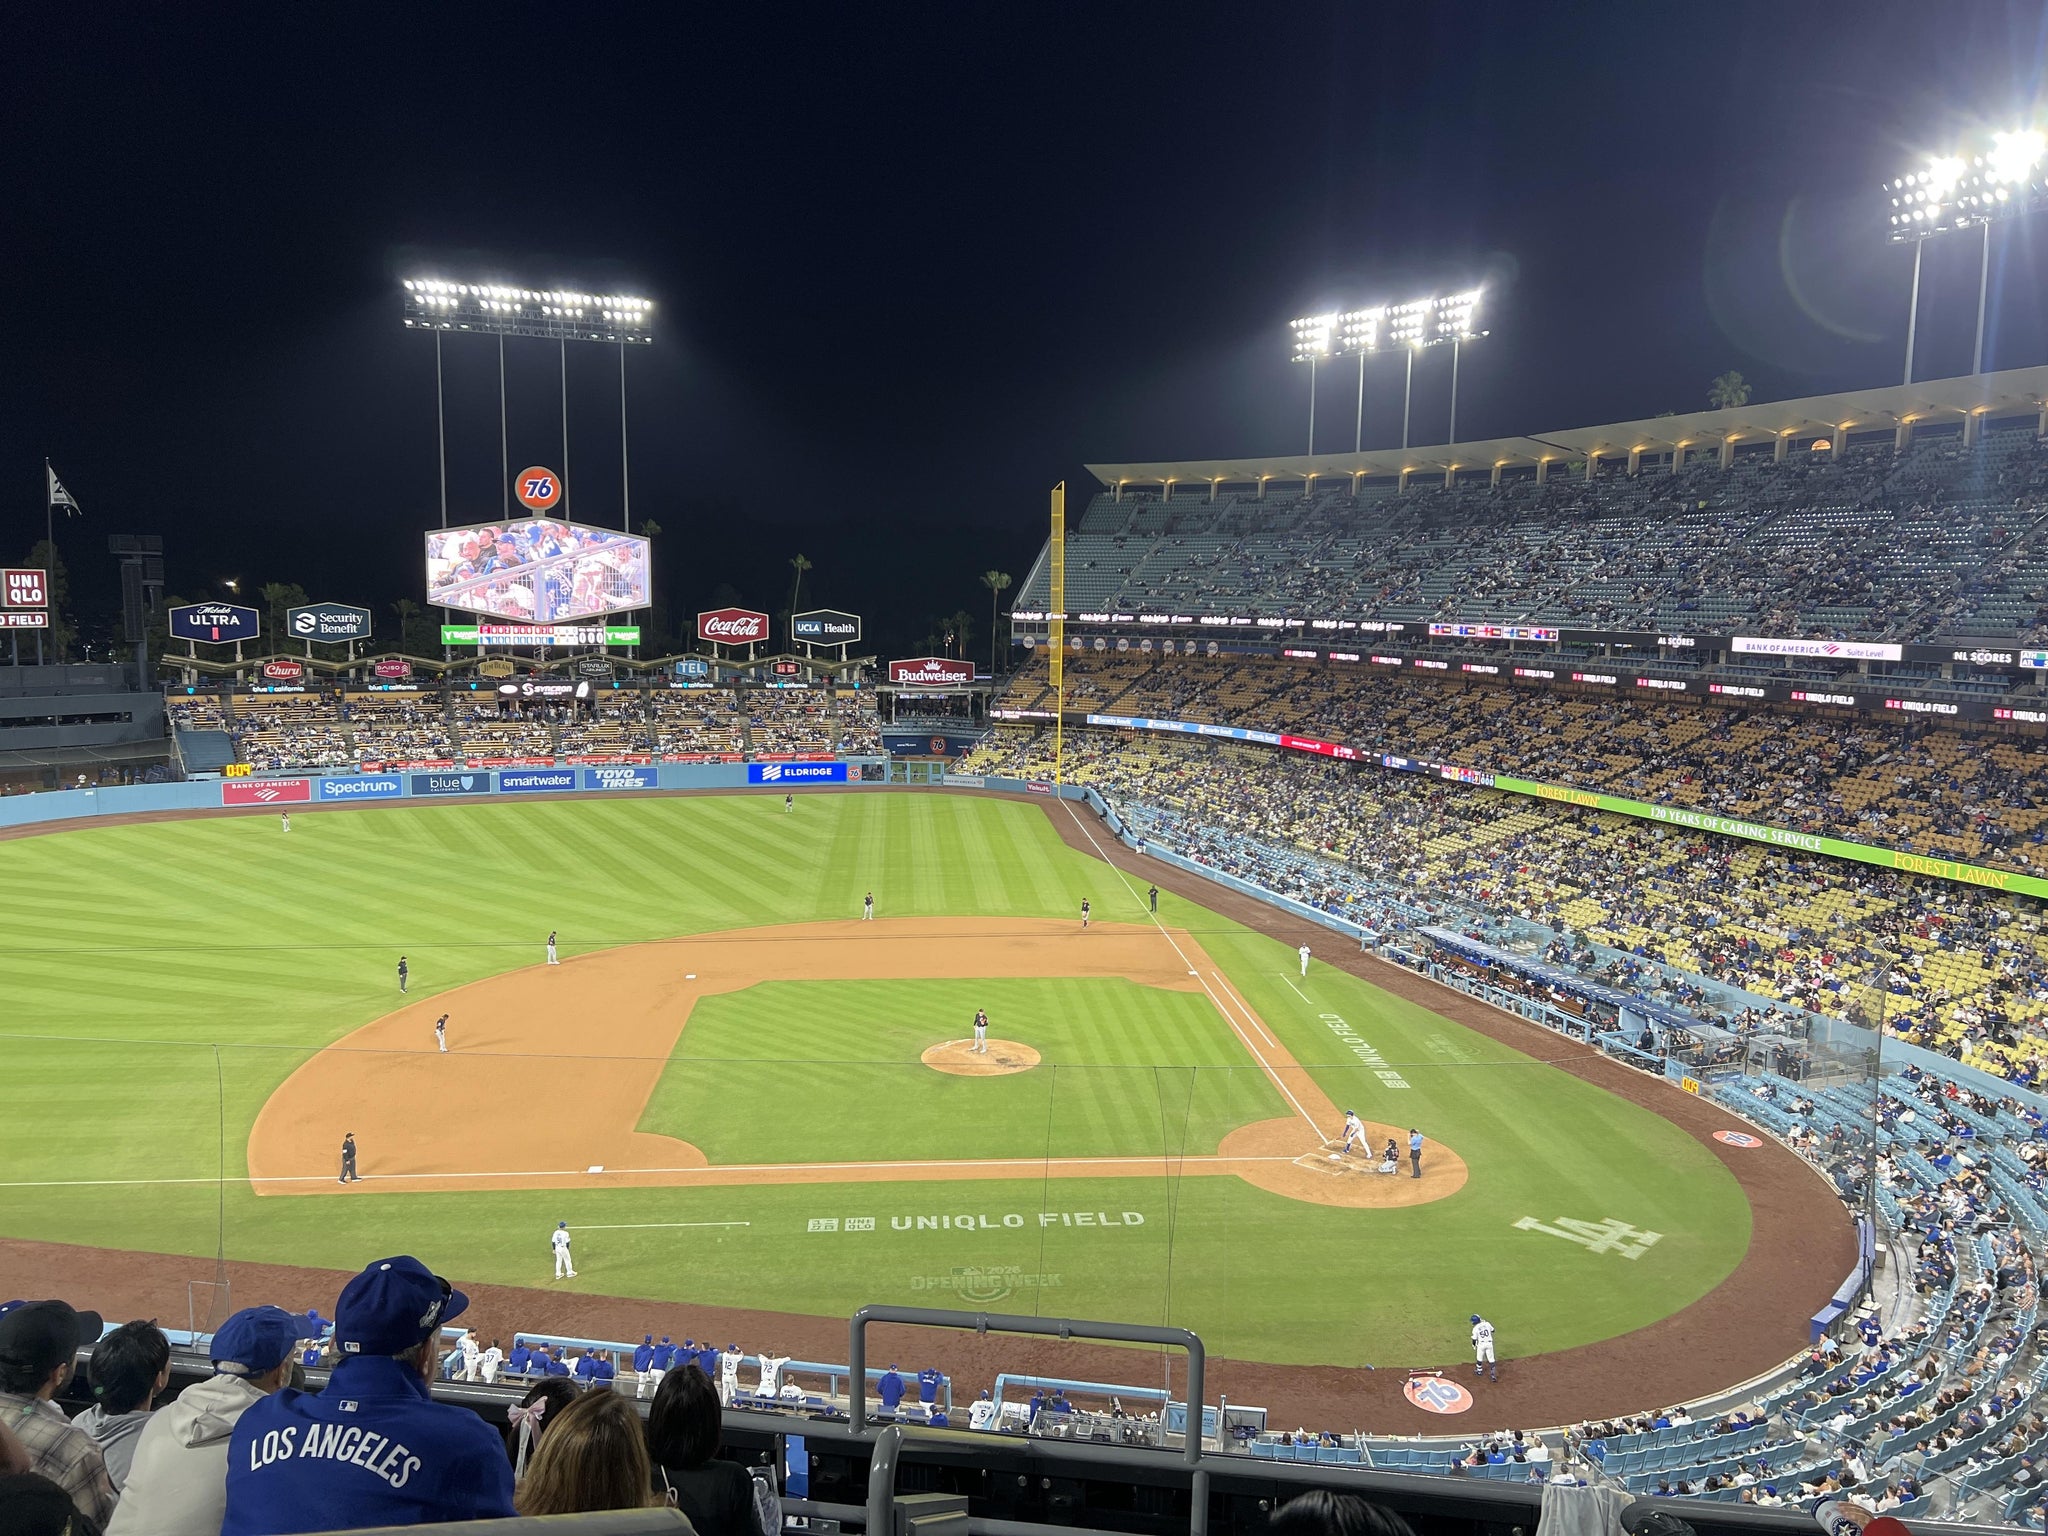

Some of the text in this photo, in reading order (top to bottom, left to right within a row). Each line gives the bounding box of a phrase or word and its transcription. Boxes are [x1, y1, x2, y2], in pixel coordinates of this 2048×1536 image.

[524, 477, 553, 499] 76
[9, 574, 38, 588] UNI
[11, 589, 42, 604] QLO
[8, 615, 43, 625] FIELD
[189, 615, 240, 625] ULTRA
[320, 613, 363, 624] Security
[321, 623, 358, 633] Benefit
[705, 616, 762, 635] Coca-Cola
[797, 623, 855, 633] UCLA Health
[1658, 637, 1695, 646] AL SCORES
[1747, 643, 1767, 651] BANK
[1782, 645, 1820, 654] AMERICA
[1953, 652, 2012, 663] NL SCORES
[266, 665, 299, 675] Churu
[483, 663, 511, 673] JIM BEAM
[680, 663, 704, 673] TEL
[1722, 685, 1764, 697] UNIQLO FIELD
[1805, 692, 1855, 705] UNIQLO FIELD
[1902, 700, 1958, 714] UNIQLO FIELD
[2012, 711, 2046, 722] UNIQLO
[932, 740, 944, 750] 76
[226, 764, 251, 777] 0:09
[594, 769, 635, 779] TOYO
[784, 767, 832, 776] ELDRIDGE
[850, 769, 859, 777] 76
[430, 777, 460, 788] blue
[503, 776, 571, 787] smartwater
[602, 778, 645, 788] TIRES
[325, 781, 391, 797] Spectrum
[1027, 784, 1050, 792] Yakult
[1536, 784, 1600, 806] FOREST LAWN
[1650, 807, 1821, 849] 120 YEARS OF CARING SERVICE
[1894, 851, 2005, 888] FOREST LAWN
[1318, 1013, 1390, 1069] UNIQLO FIELD
[891, 1211, 1145, 1232] UNIQLO FIELD
[1511, 1216, 1664, 1261] LA
[910, 1272, 1063, 1290] OPENING WEEK
[1480, 1329, 1489, 1338] 50
[486, 1355, 494, 1363] 37
[725, 1361, 732, 1370] 12
[763, 1364, 773, 1373] 72
[1416, 1379, 1461, 1411] 76
[980, 1409, 986, 1418] 5
[251, 1423, 421, 1489] LOS ANGELES
